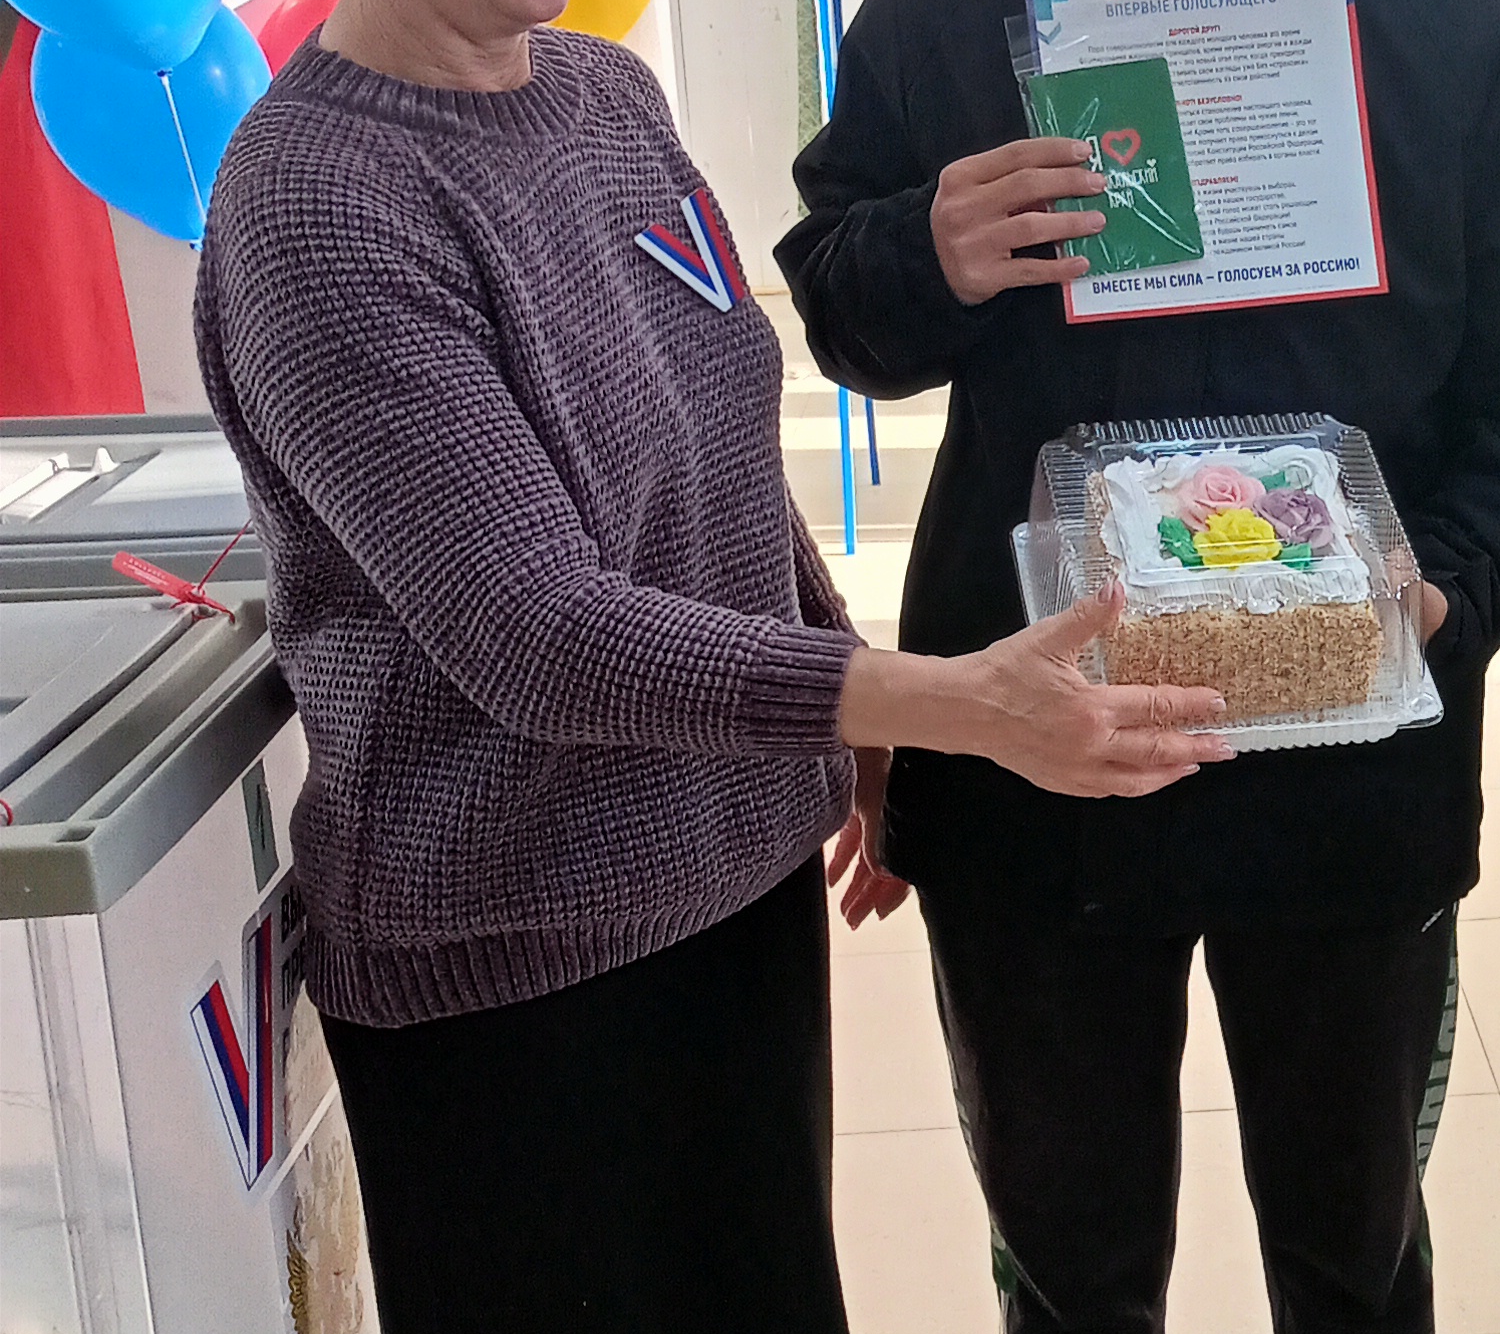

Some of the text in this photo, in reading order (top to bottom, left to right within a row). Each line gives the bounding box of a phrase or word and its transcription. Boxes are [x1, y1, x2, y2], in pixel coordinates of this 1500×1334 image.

[1085, 136, 1103, 172] Я
[1092, 277, 1141, 294] ВМЕСТЕ
[1144, 275, 1167, 290] МЫ
[1170, 272, 1203, 288] СИЛА
[1217, 265, 1282, 283] ГОЛОСУЕМ
[1285, 263, 1301, 277] ЗА
[1303, 257, 1360, 275] РОССИЮ!
